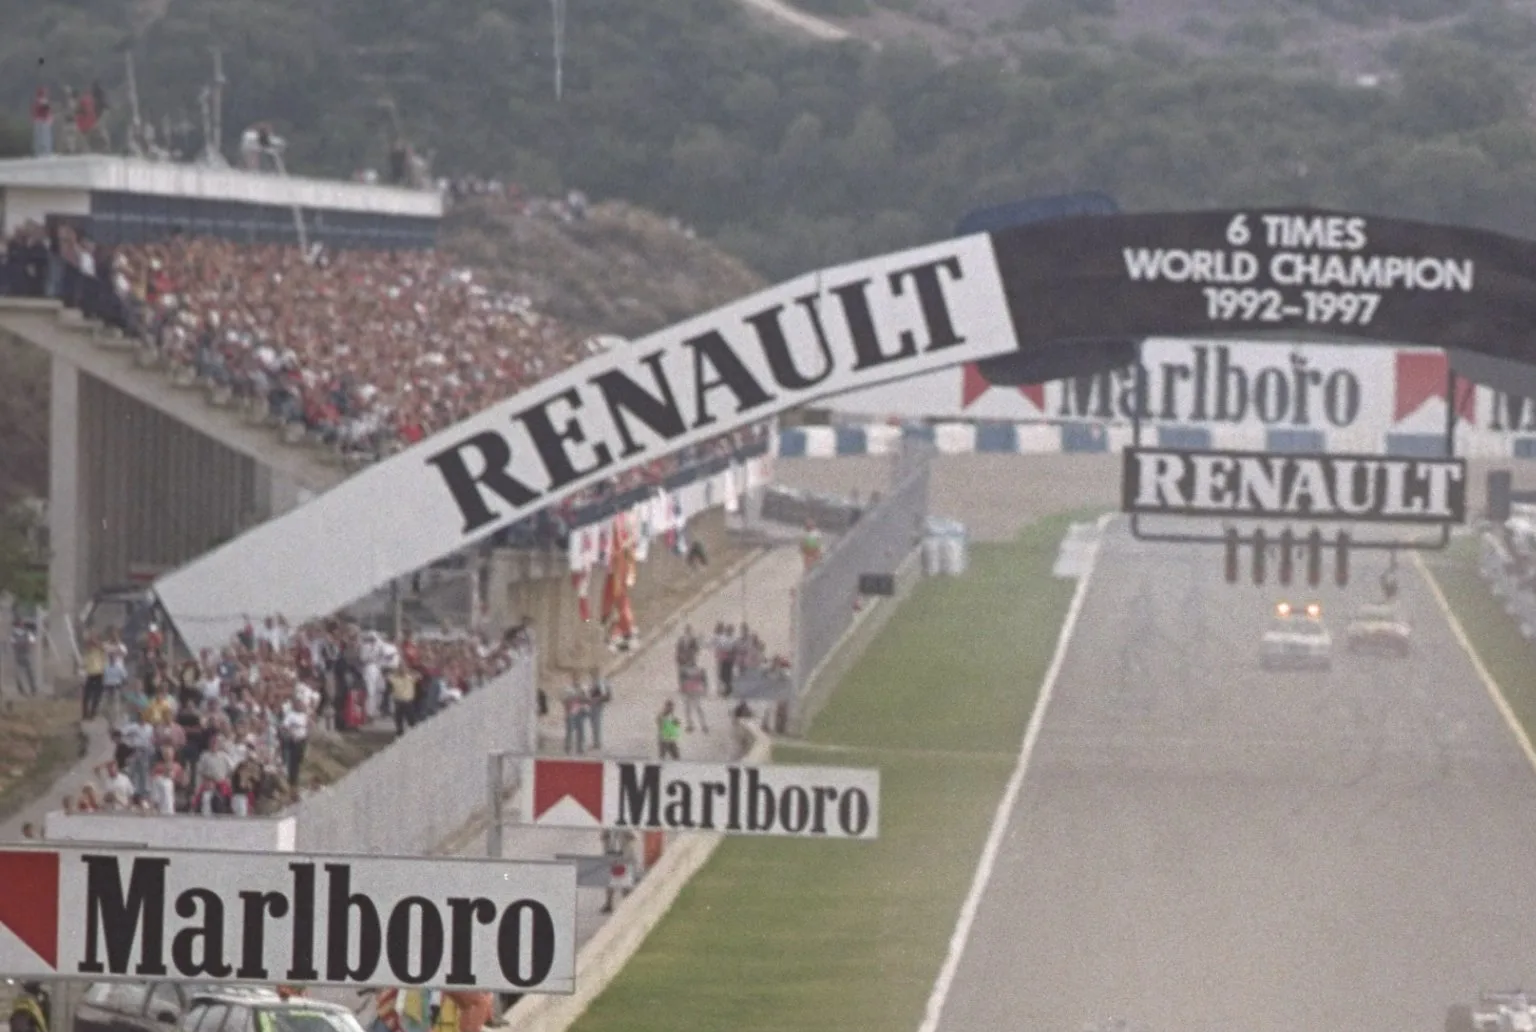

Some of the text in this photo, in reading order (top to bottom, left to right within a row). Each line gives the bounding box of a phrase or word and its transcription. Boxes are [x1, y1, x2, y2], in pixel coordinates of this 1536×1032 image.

[1225, 214, 1367, 250] 6 TIMES
[1123, 248, 1474, 291] WORLD CHAMPION
[425, 256, 966, 534] RENAULT
[1134, 452, 1462, 516] RENAULT
[617, 762, 870, 836] Marlboro
[77, 853, 556, 989] Marlboro
